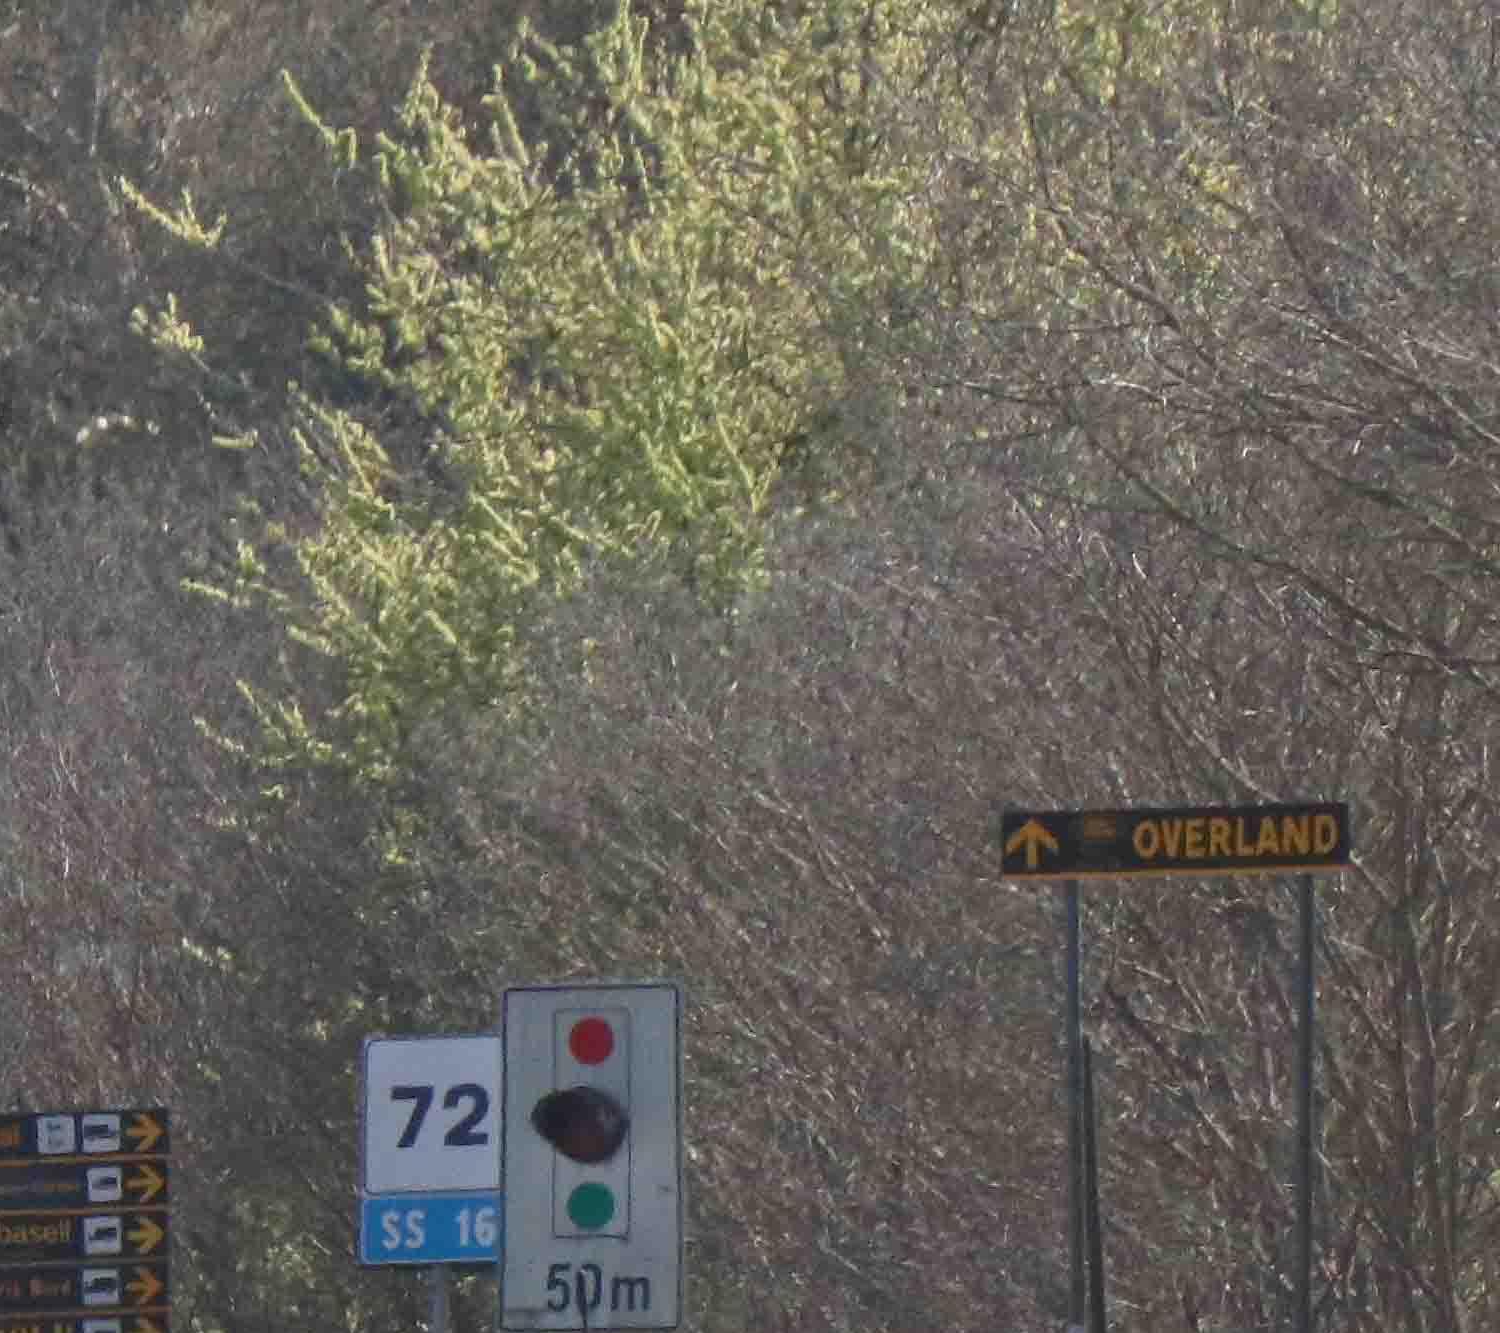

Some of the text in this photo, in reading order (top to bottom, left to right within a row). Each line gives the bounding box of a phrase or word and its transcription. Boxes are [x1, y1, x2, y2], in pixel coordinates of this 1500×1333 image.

[1132, 814, 1339, 859] OVERLAND
[390, 1083, 490, 1148] 72
[381, 1206, 496, 1250] SS 16
